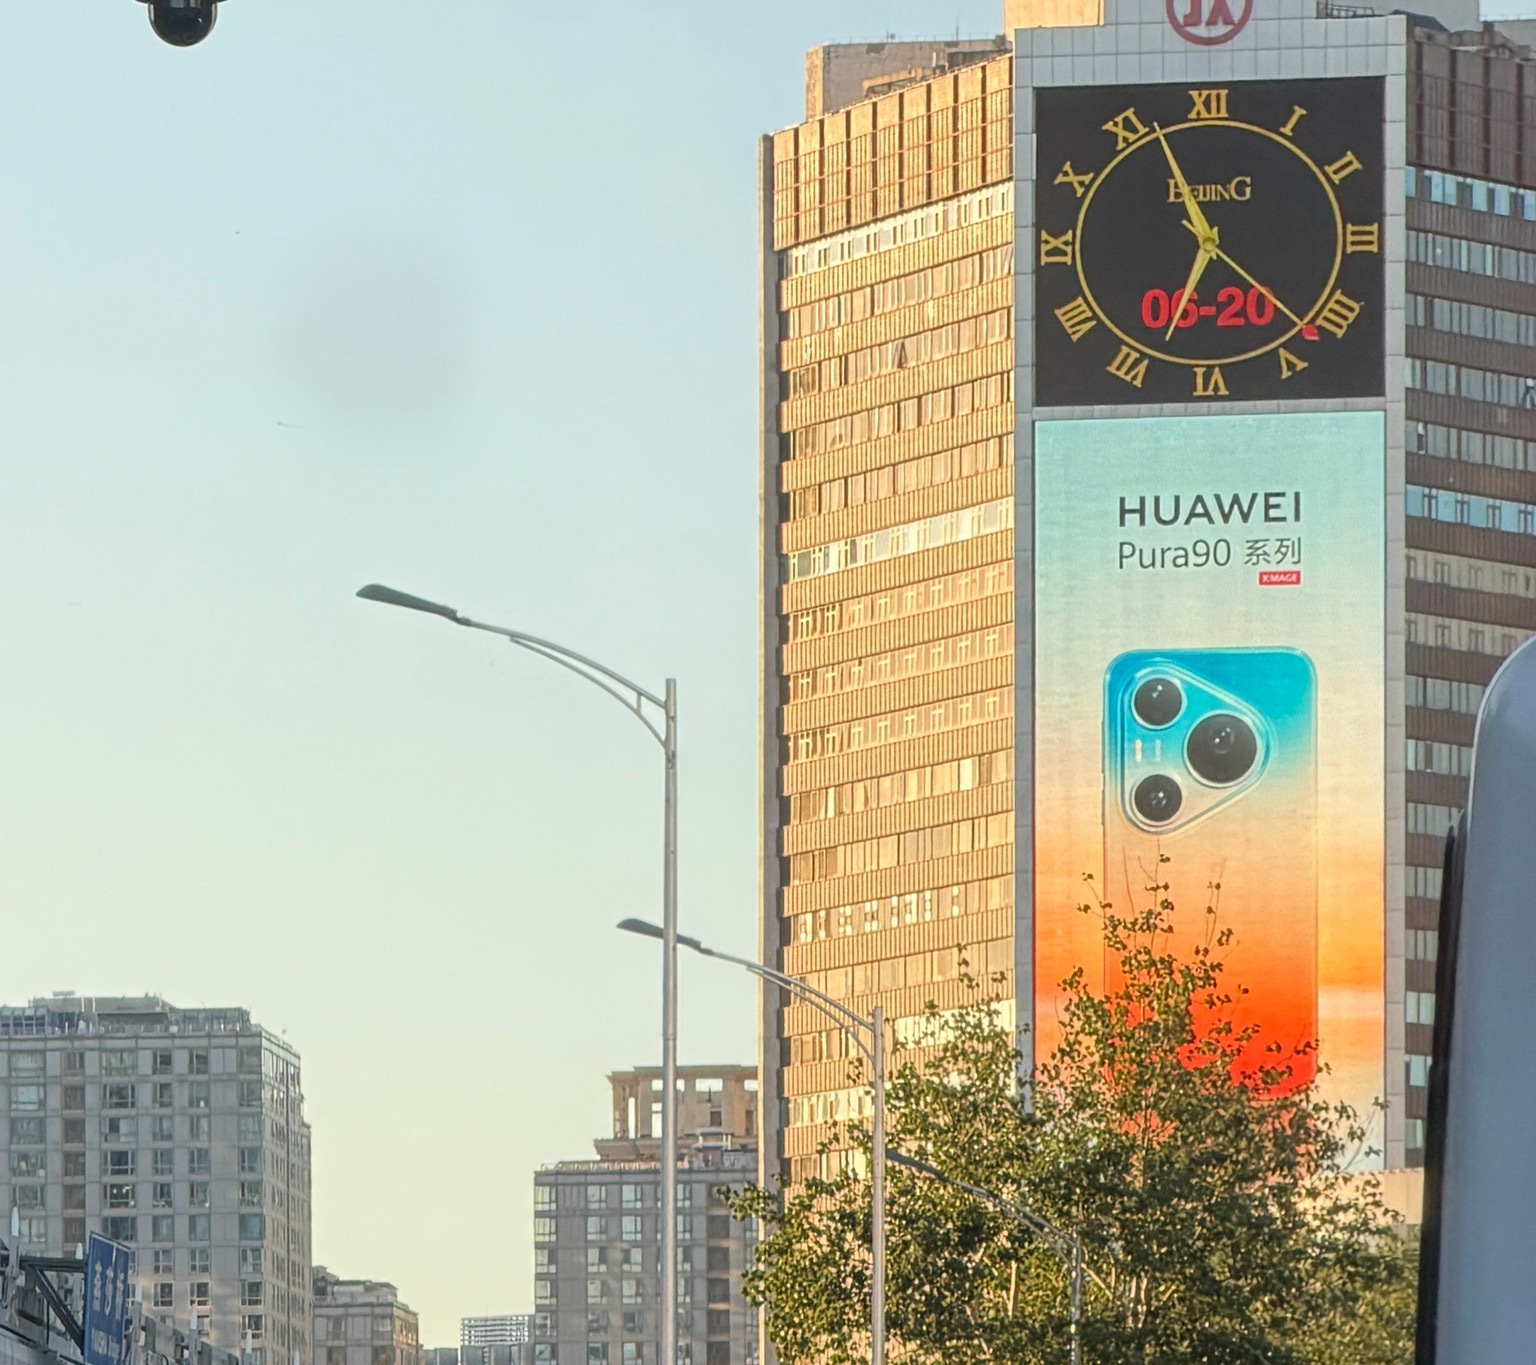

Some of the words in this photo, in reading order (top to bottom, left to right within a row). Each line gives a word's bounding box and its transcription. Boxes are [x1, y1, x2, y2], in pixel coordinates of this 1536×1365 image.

[1188, 89, 1229, 119] XII
[1141, 287, 1276, 328] 06-20
[1119, 491, 1301, 527] HUAWEI
[1119, 539, 1232, 570] Pura90
[1244, 537, 1302, 566] 系列
